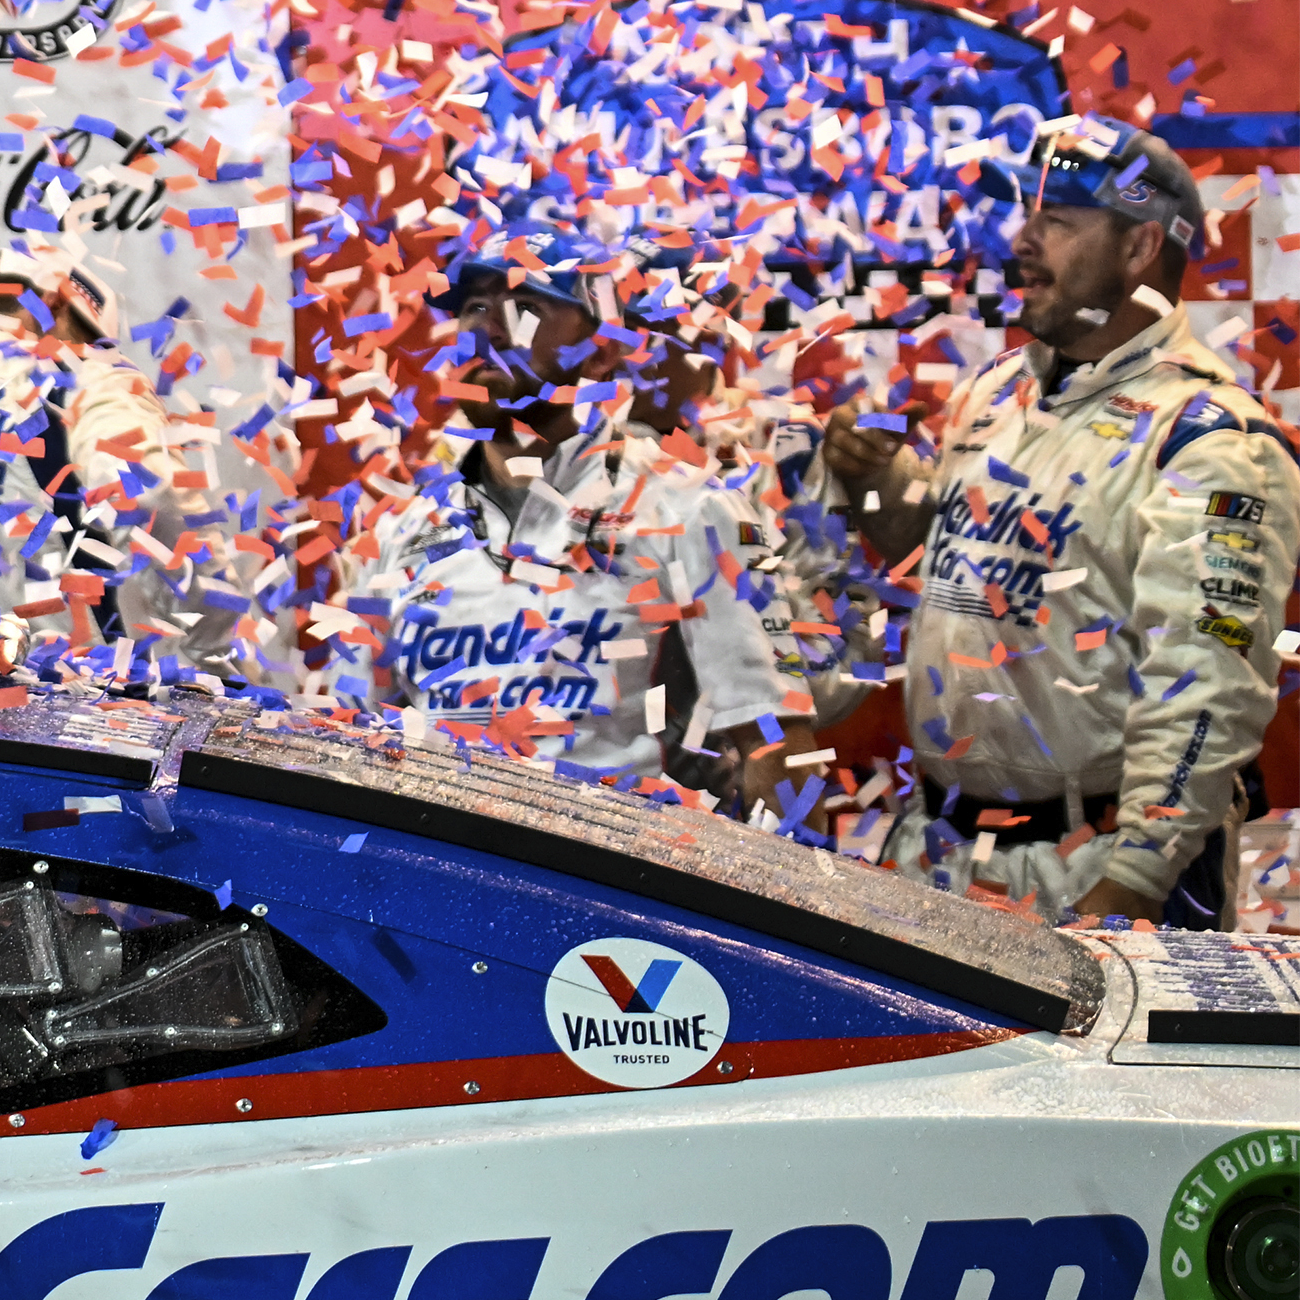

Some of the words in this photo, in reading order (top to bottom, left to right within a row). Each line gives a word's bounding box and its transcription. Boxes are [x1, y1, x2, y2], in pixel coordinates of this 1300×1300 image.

[1118, 179, 1157, 207] 5
[562, 1012, 708, 1053] VALVOLINE
[612, 1054, 671, 1066] TRUSTED
[1173, 1174, 1216, 1231] GET
